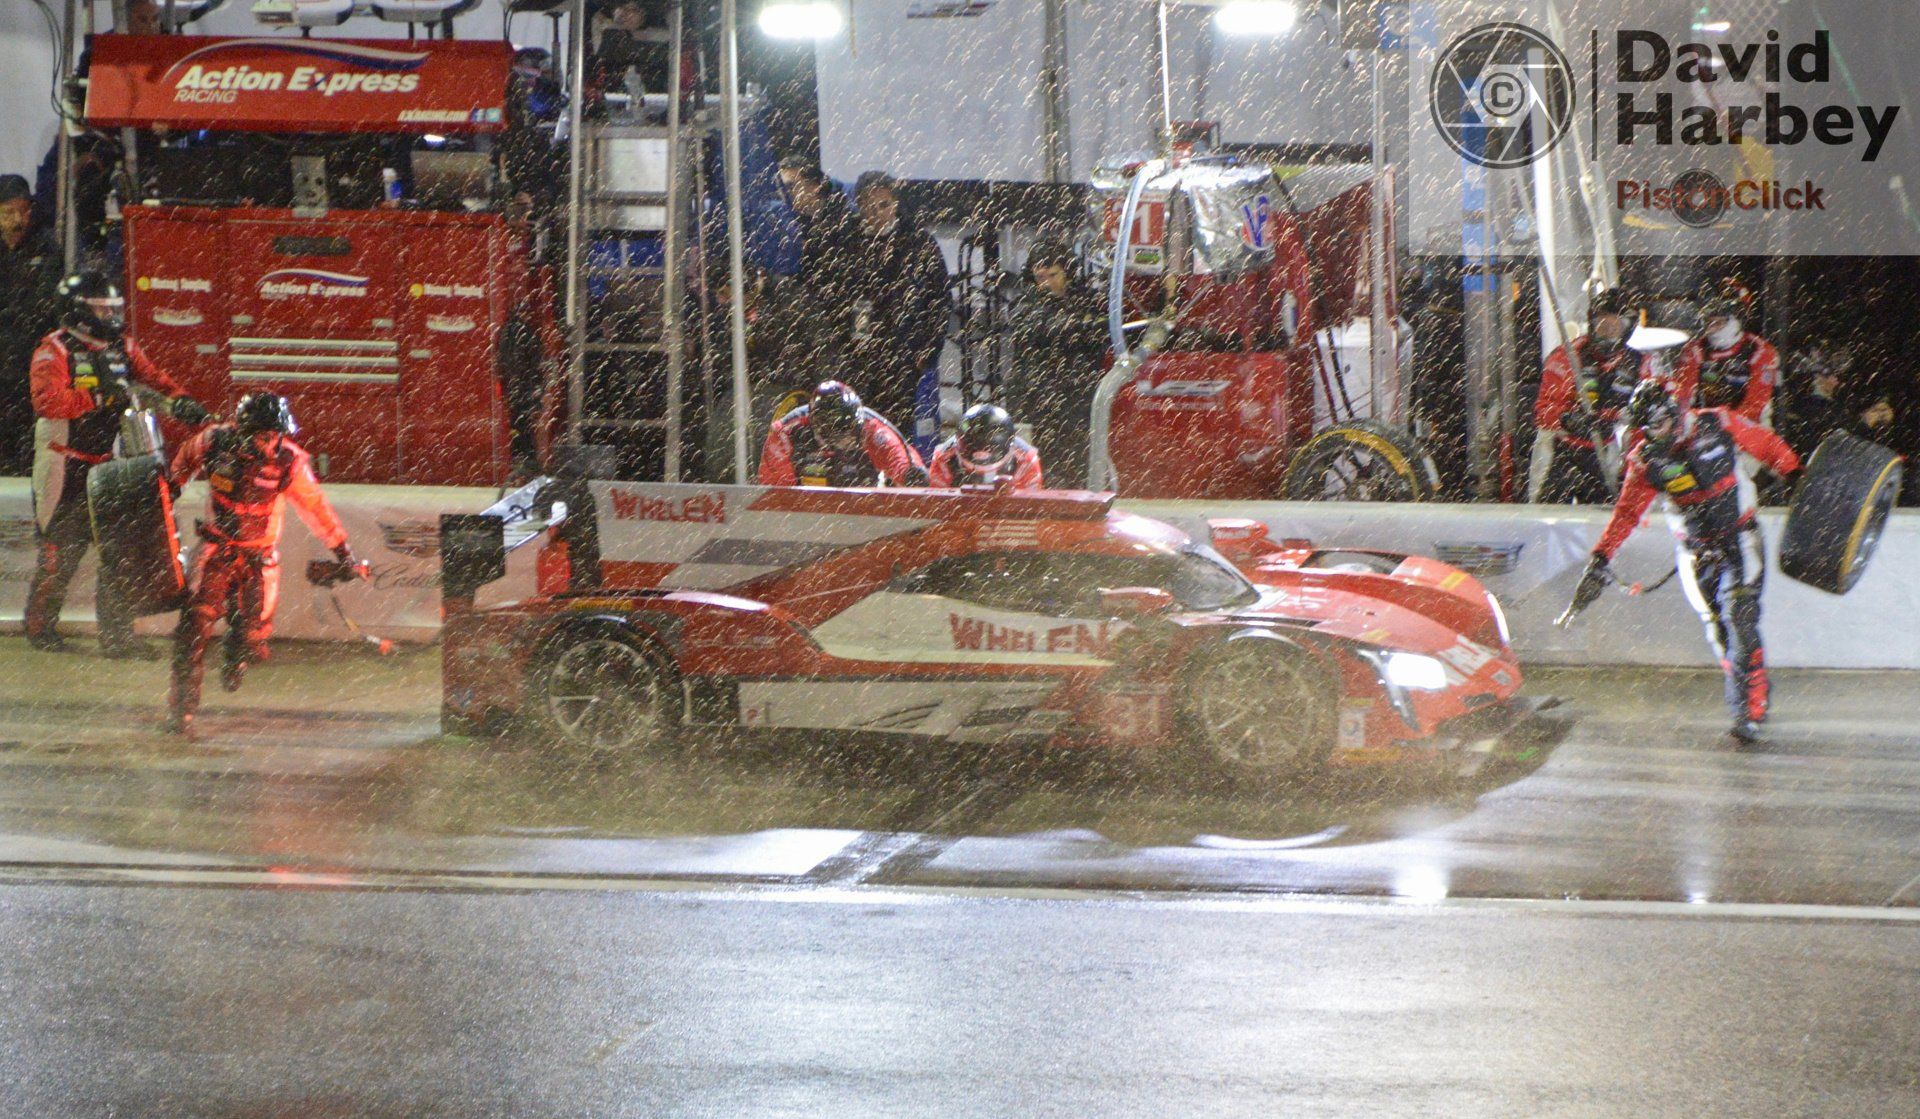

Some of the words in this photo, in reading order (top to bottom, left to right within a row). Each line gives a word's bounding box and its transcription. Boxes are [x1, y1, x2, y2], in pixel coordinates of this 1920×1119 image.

[175, 65, 284, 92] Action
[287, 67, 421, 96] Express
[173, 89, 238, 104] RACING
[260, 281, 308, 295] Action
[308, 282, 367, 298] Express
[609, 488, 727, 524] WHELEN
[950, 611, 1111, 659] WHELEN
